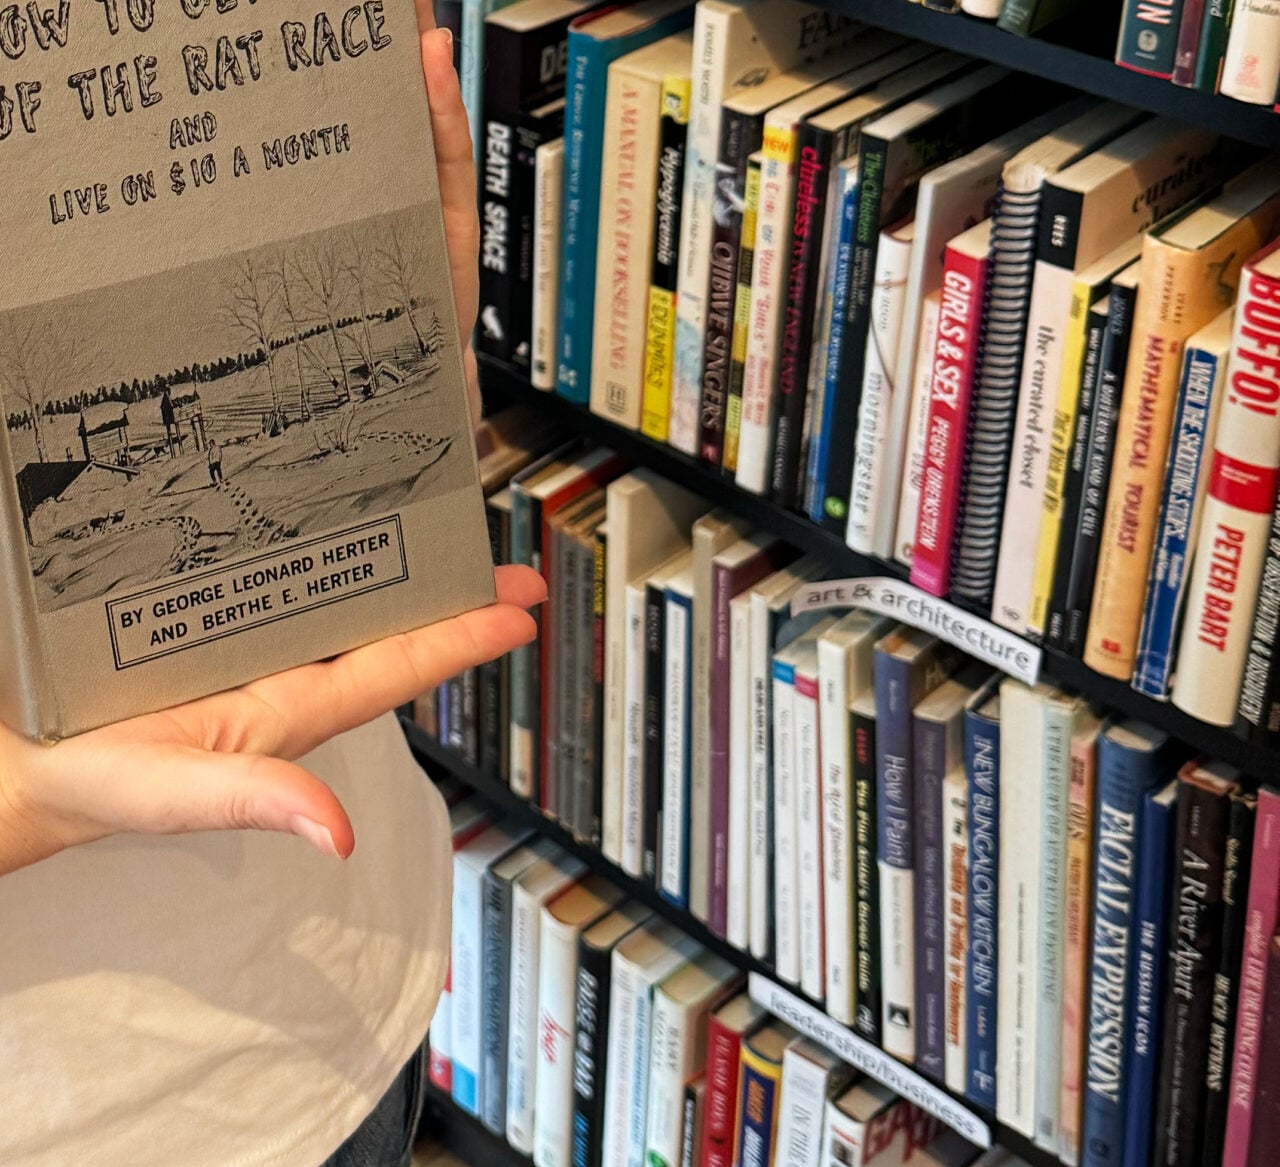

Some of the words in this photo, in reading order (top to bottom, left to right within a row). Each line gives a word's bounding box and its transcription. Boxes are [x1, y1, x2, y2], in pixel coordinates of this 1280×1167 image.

[68, 54, 163, 120] THE
[182, 30, 263, 96] RAT
[280, 0, 392, 71] RACE
[169, 111, 217, 149] AND
[484, 120, 513, 197] DEATH
[49, 183, 110, 224] LIVE
[121, 171, 157, 206] ON
[169, 154, 217, 196] $10
[233, 146, 251, 177] A
[263, 124, 352, 171] MONTH
[655, 146, 680, 265] Hypoglycemia
[792, 145, 823, 238] clueless
[482, 201, 509, 274] SPACE
[938, 270, 973, 343] GIRLS
[1159, 265, 1176, 323] PETERSON
[647, 306, 669, 389] DUMMIES
[936, 339, 964, 359] &
[1036, 324, 1058, 357] the
[701, 331, 730, 430] SINGERS
[930, 359, 960, 411] SEX
[1025, 359, 1048, 431] curated
[1129, 334, 1165, 470] MATHEMATICAL
[1185, 359, 1216, 405] WHEN
[927, 415, 952, 467] PEGGY
[1184, 405, 1208, 430] THE
[1018, 433, 1040, 491] closet
[1171, 432, 1204, 495] SHOOTING
[1117, 480, 1144, 555] TOURIST
[120, 607, 144, 629] BY
[152, 583, 226, 618] GEORGE
[232, 555, 314, 595] LEONARD
[322, 531, 391, 567] HERTER
[1206, 523, 1246, 593] PETER
[149, 621, 189, 647] AND
[202, 595, 274, 631] BERTHE
[282, 587, 299, 605] E.
[307, 562, 375, 598] HERTER
[806, 586, 846, 607] art
[850, 586, 875, 605] &
[879, 586, 1032, 673] architecture
[1198, 593, 1237, 654] BART
[1251, 556, 1280, 640] OBSERVATION
[1238, 653, 1264, 727] DISCOVERY
[883, 753, 908, 803] How
[973, 741, 995, 794] NEW
[885, 816, 910, 867] Paint
[972, 793, 995, 914] BUNGALOW
[1096, 801, 1136, 914] FACIAL
[1182, 848, 1211, 871] A
[1140, 918, 1157, 949] THE
[1178, 875, 1210, 942] River
[973, 913, 996, 998] KITCHEN
[1137, 951, 1156, 1014] RUSSIAN
[1168, 939, 1203, 1001] Apart
[1086, 915, 1131, 1105] EXPRESSION
[1133, 1015, 1151, 1058] ICON
